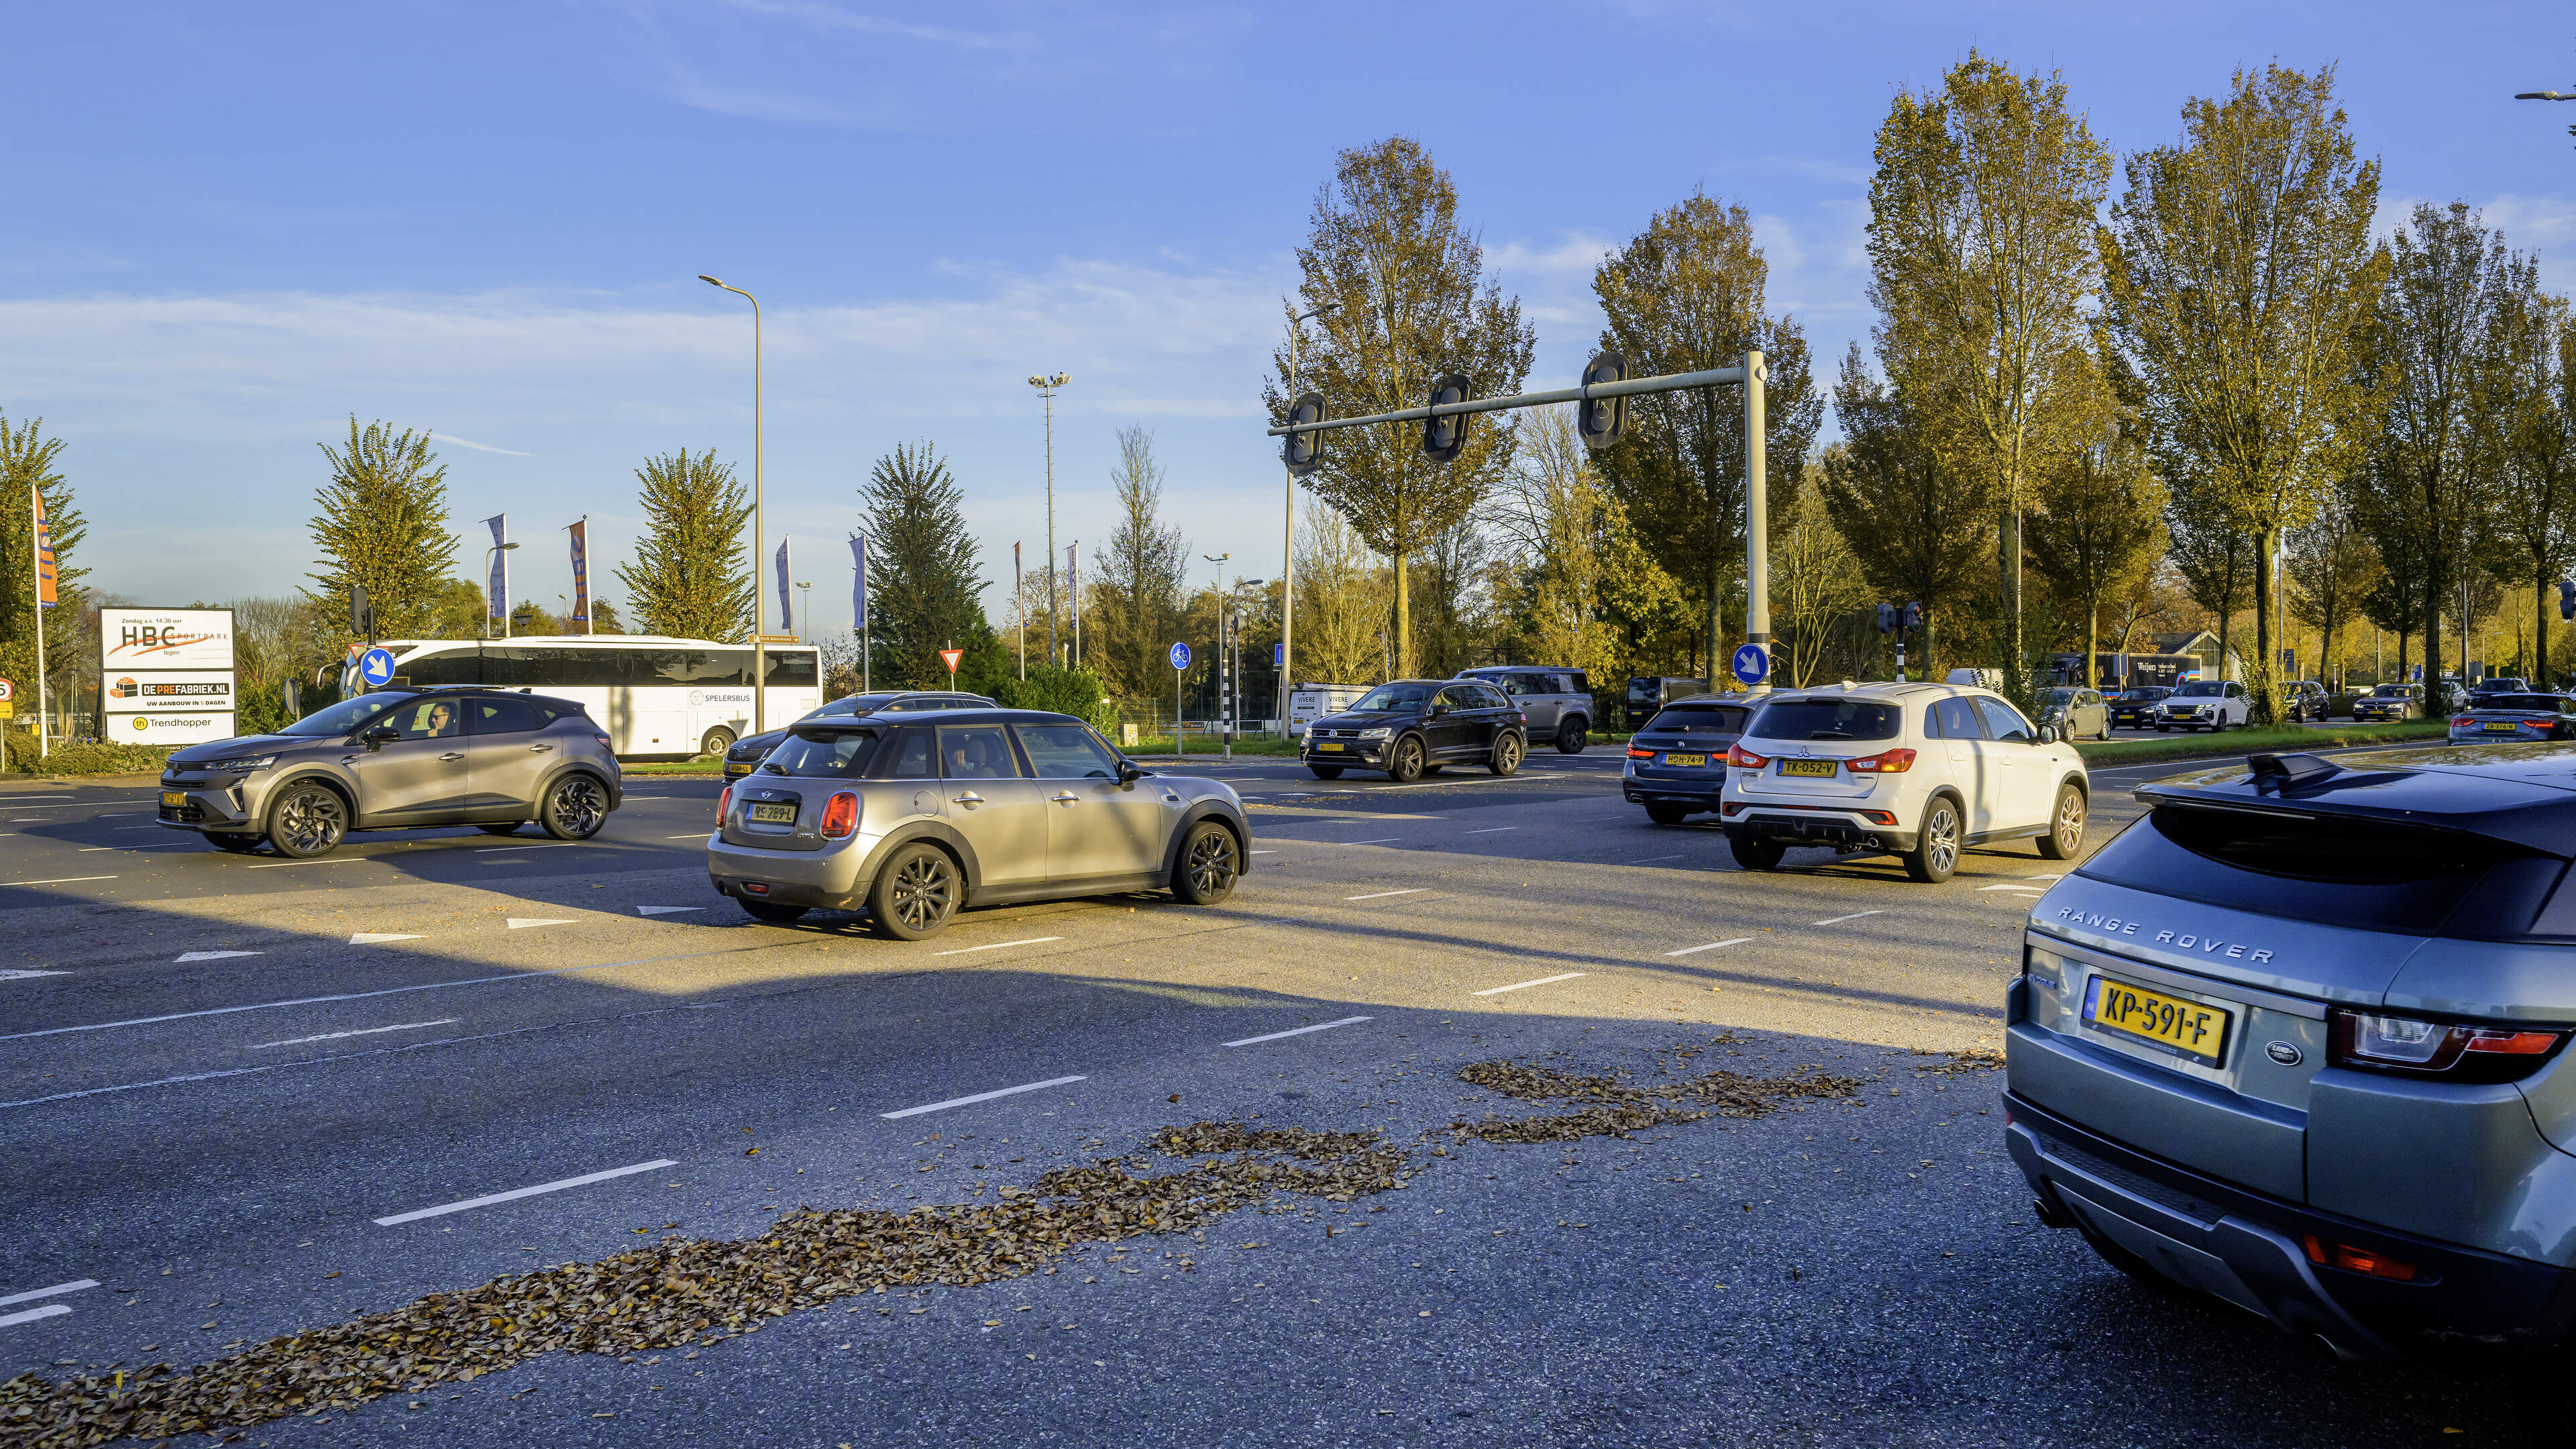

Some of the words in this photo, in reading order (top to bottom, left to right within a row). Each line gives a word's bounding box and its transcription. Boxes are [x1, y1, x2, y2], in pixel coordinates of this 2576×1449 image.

[121, 626, 176, 647] HBC
[2137, 662, 2156, 673] Weijers
[144, 684, 228, 694] DEPREFABRIEK.NL
[150, 718, 212, 728] Trendhopper
[1668, 755, 1703, 764] HDH-74-P
[1785, 762, 1833, 773] TK-052-V
[2057, 906, 2141, 936] RANGE
[2155, 930, 2274, 964] ROVER
[2104, 987, 2211, 1045] KP-591-F
